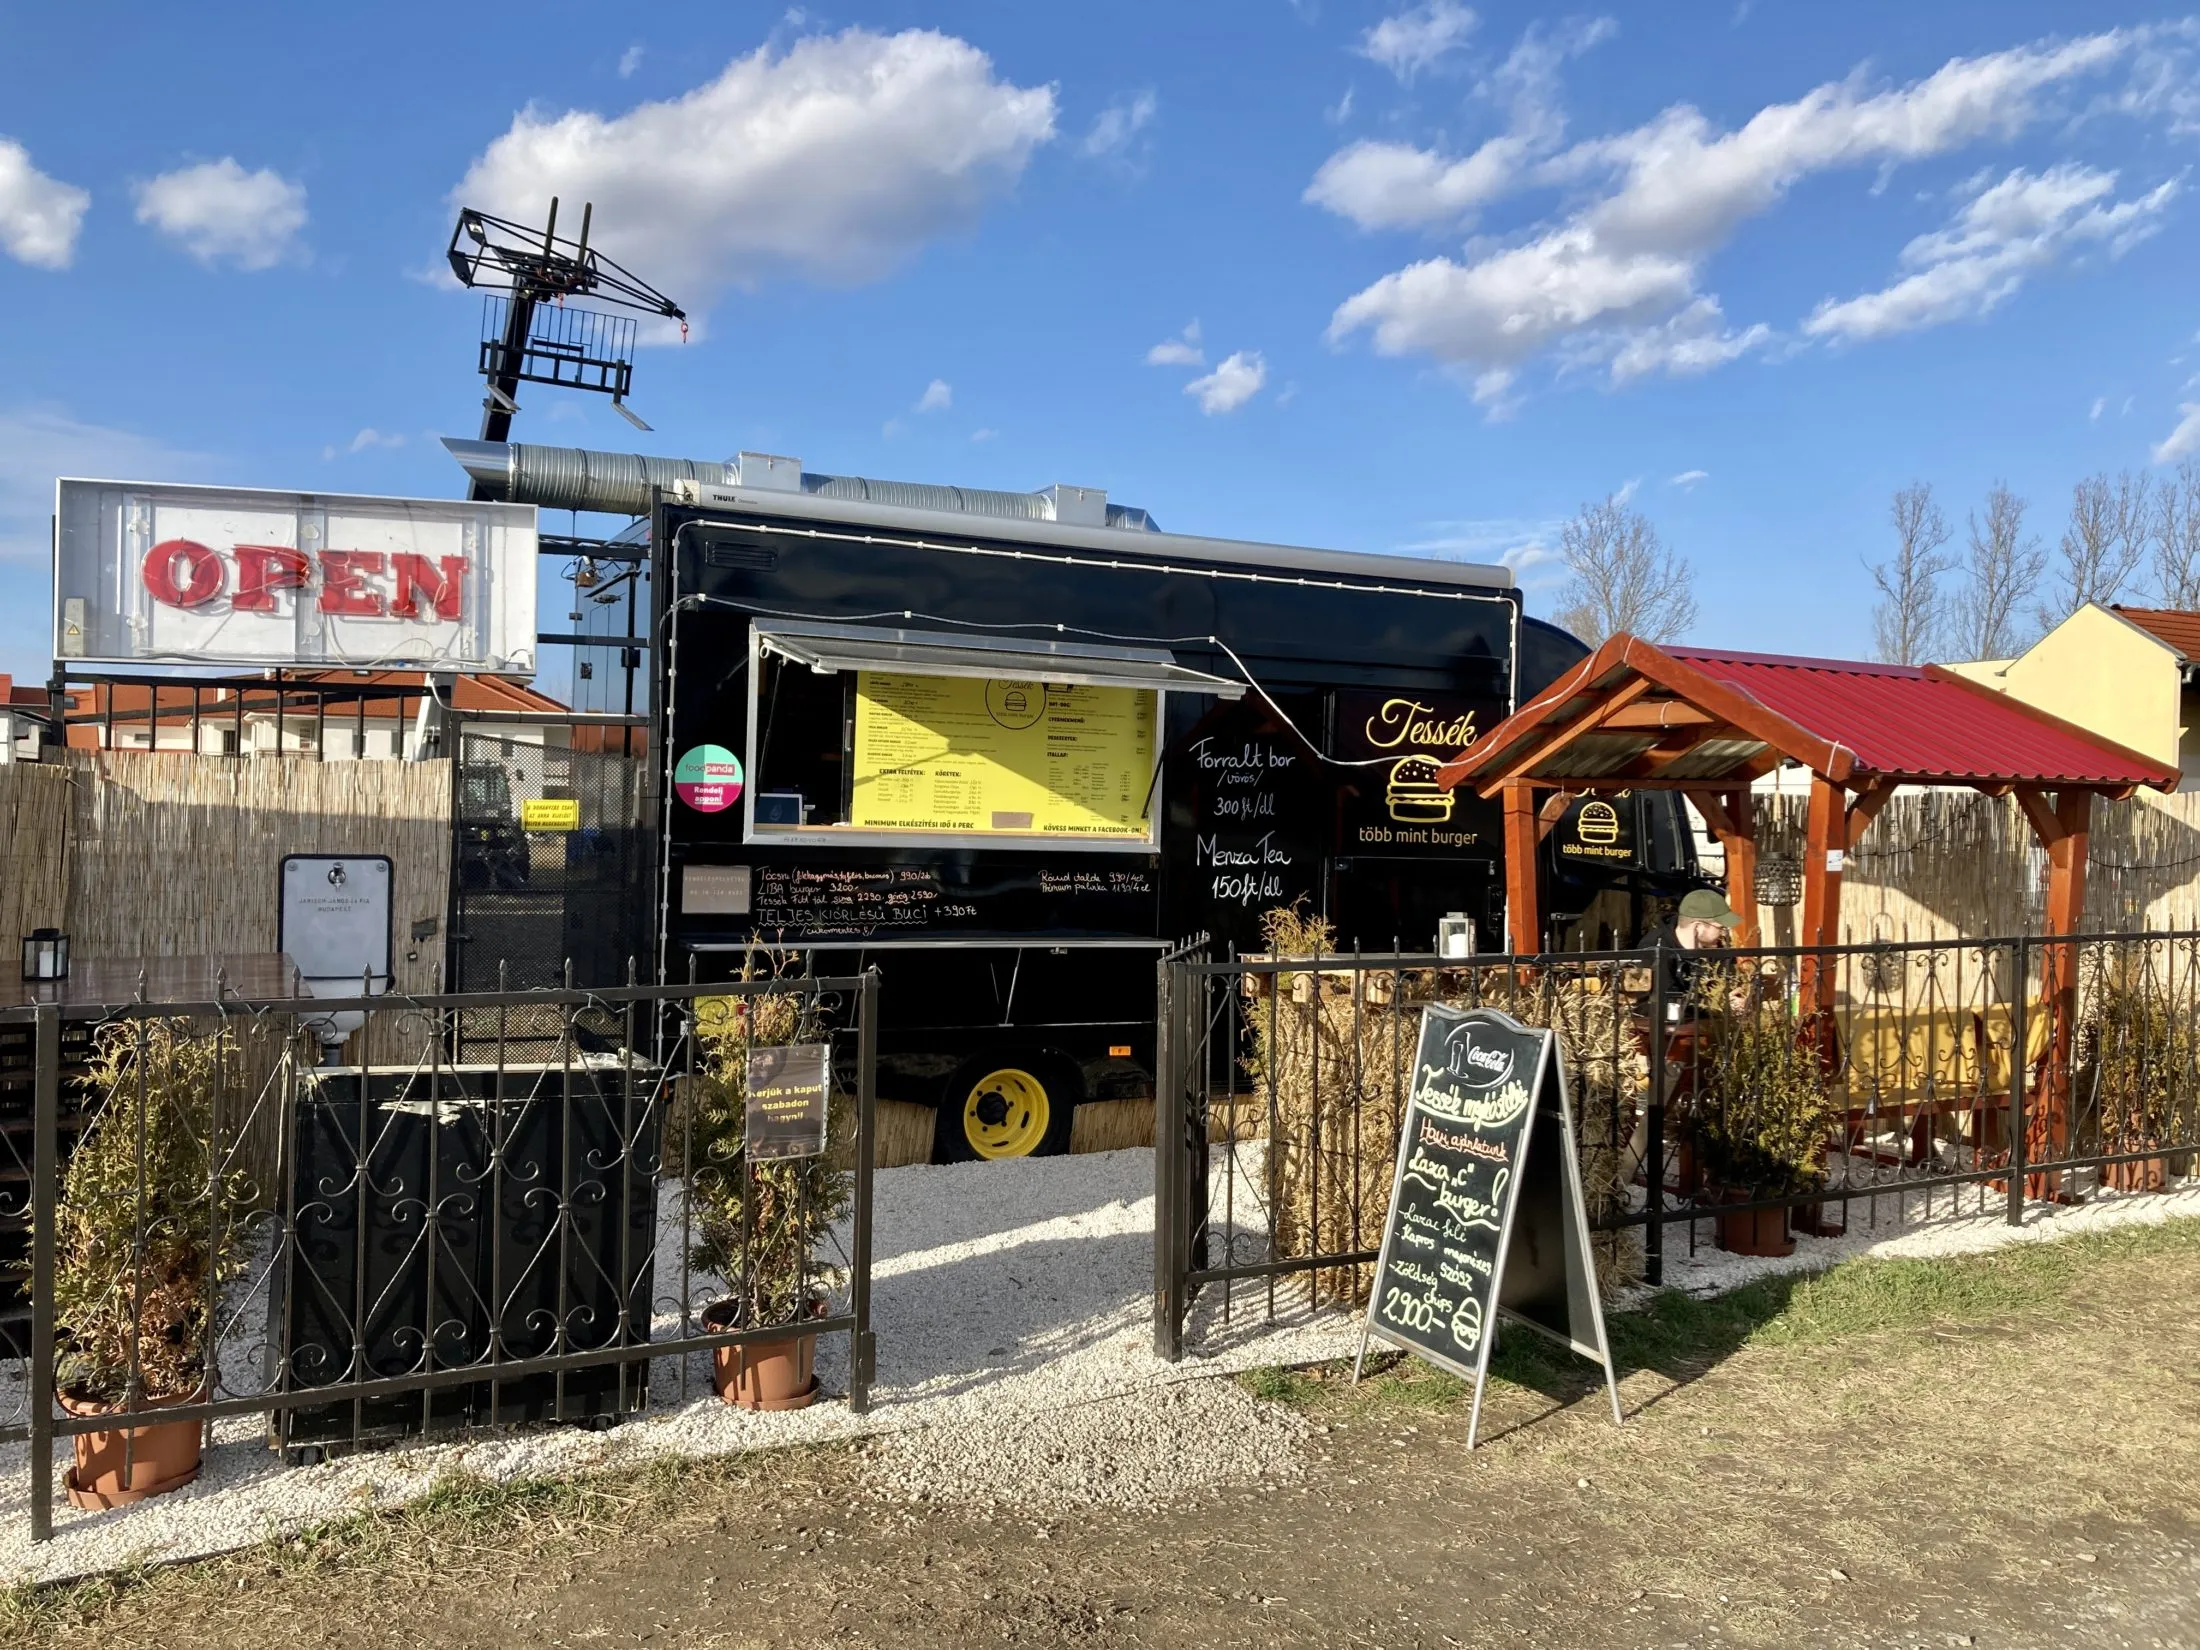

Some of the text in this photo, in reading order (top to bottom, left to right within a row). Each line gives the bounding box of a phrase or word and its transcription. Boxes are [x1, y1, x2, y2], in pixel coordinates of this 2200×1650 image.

[712, 494, 736, 502] THULE
[141, 538, 470, 621] OPEN
[1366, 698, 1478, 747] Tessék
[1189, 736, 1296, 768] Forralt bor
[685, 763, 735, 775] foodpanda
[864, 819, 898, 827] MINIMUM
[1043, 823, 1067, 832] KÖVESS
[1360, 826, 1478, 847] több mint burger
[1196, 830, 1292, 867] Menza Tea
[1562, 844, 1632, 858] több mint burger
[757, 882, 784, 895] LIBA
[789, 884, 821, 896] burger
[756, 907, 814, 923] TELJES
[784, 1087, 792, 1095] a
[793, 1083, 823, 1096] kaput
[761, 1098, 809, 1111] szabadon
